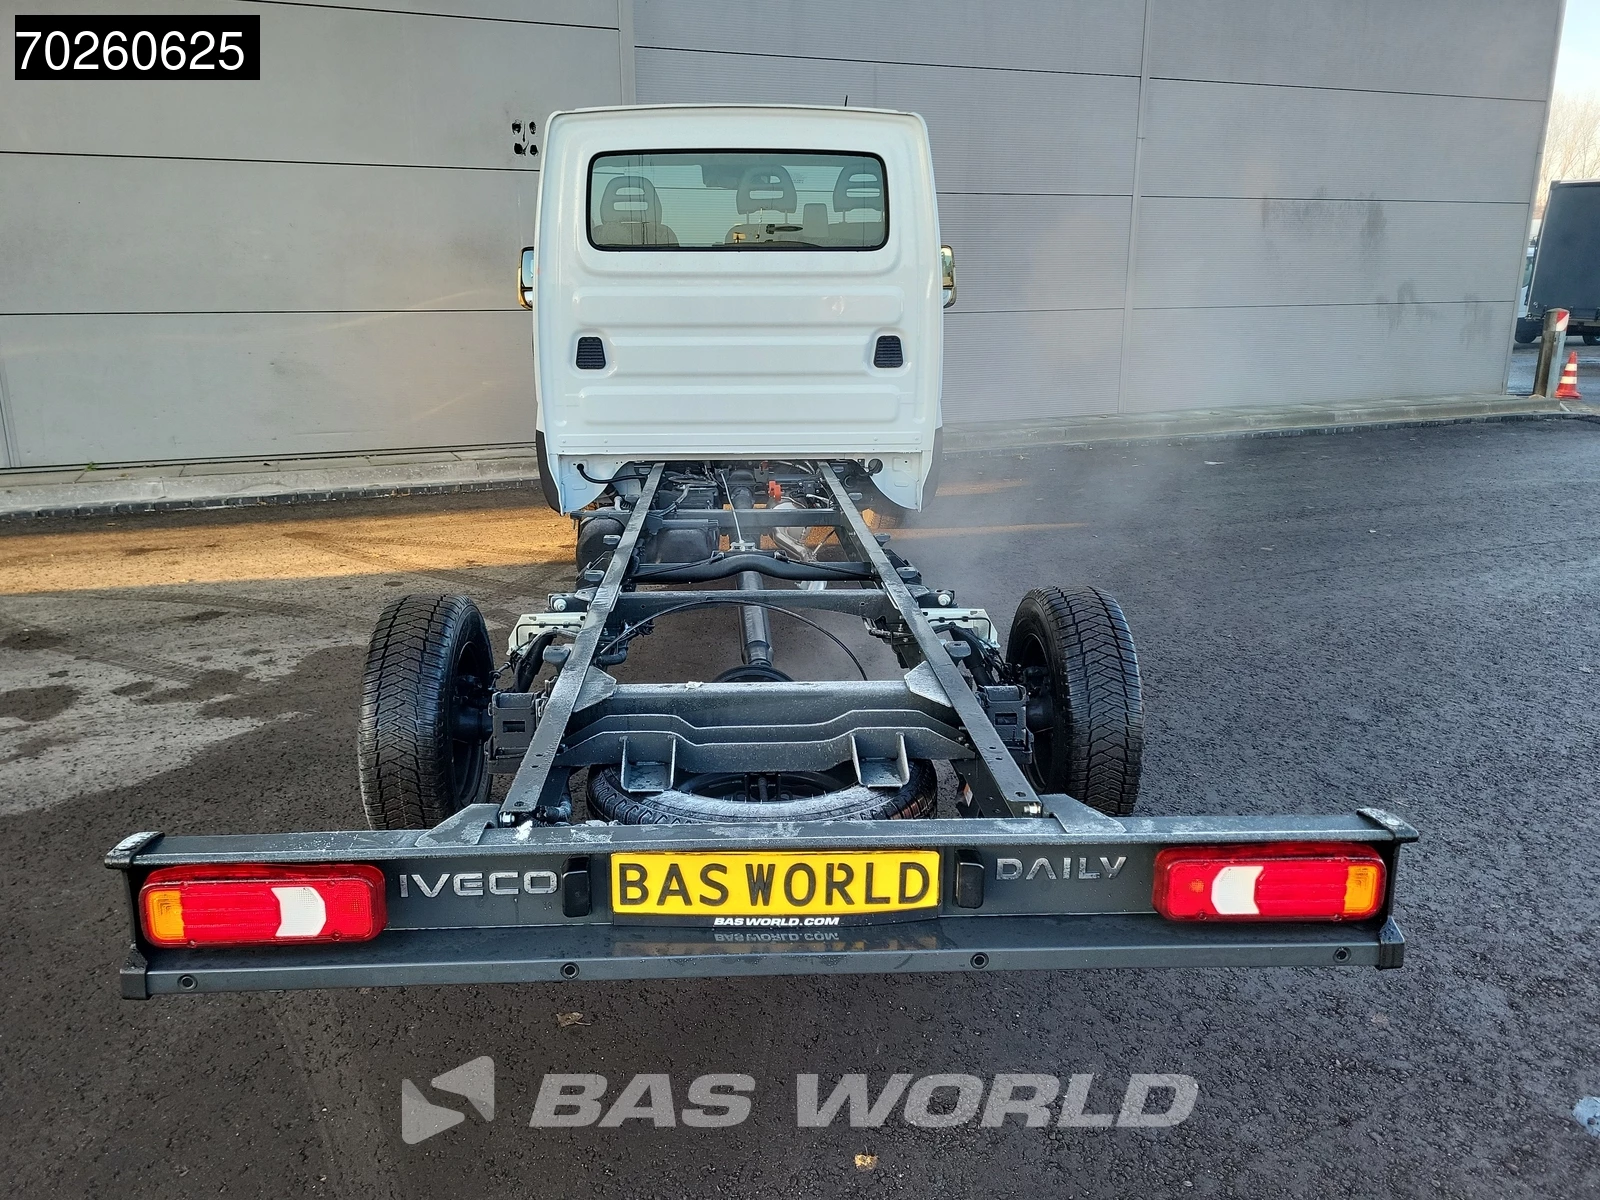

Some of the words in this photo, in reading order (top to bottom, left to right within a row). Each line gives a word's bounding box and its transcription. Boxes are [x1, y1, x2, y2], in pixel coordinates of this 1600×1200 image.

[995, 855, 1127, 880] DAILY
[399, 870, 558, 898] IVECO
[618, 863, 729, 907] BAS
[745, 861, 930, 907] WORLD
